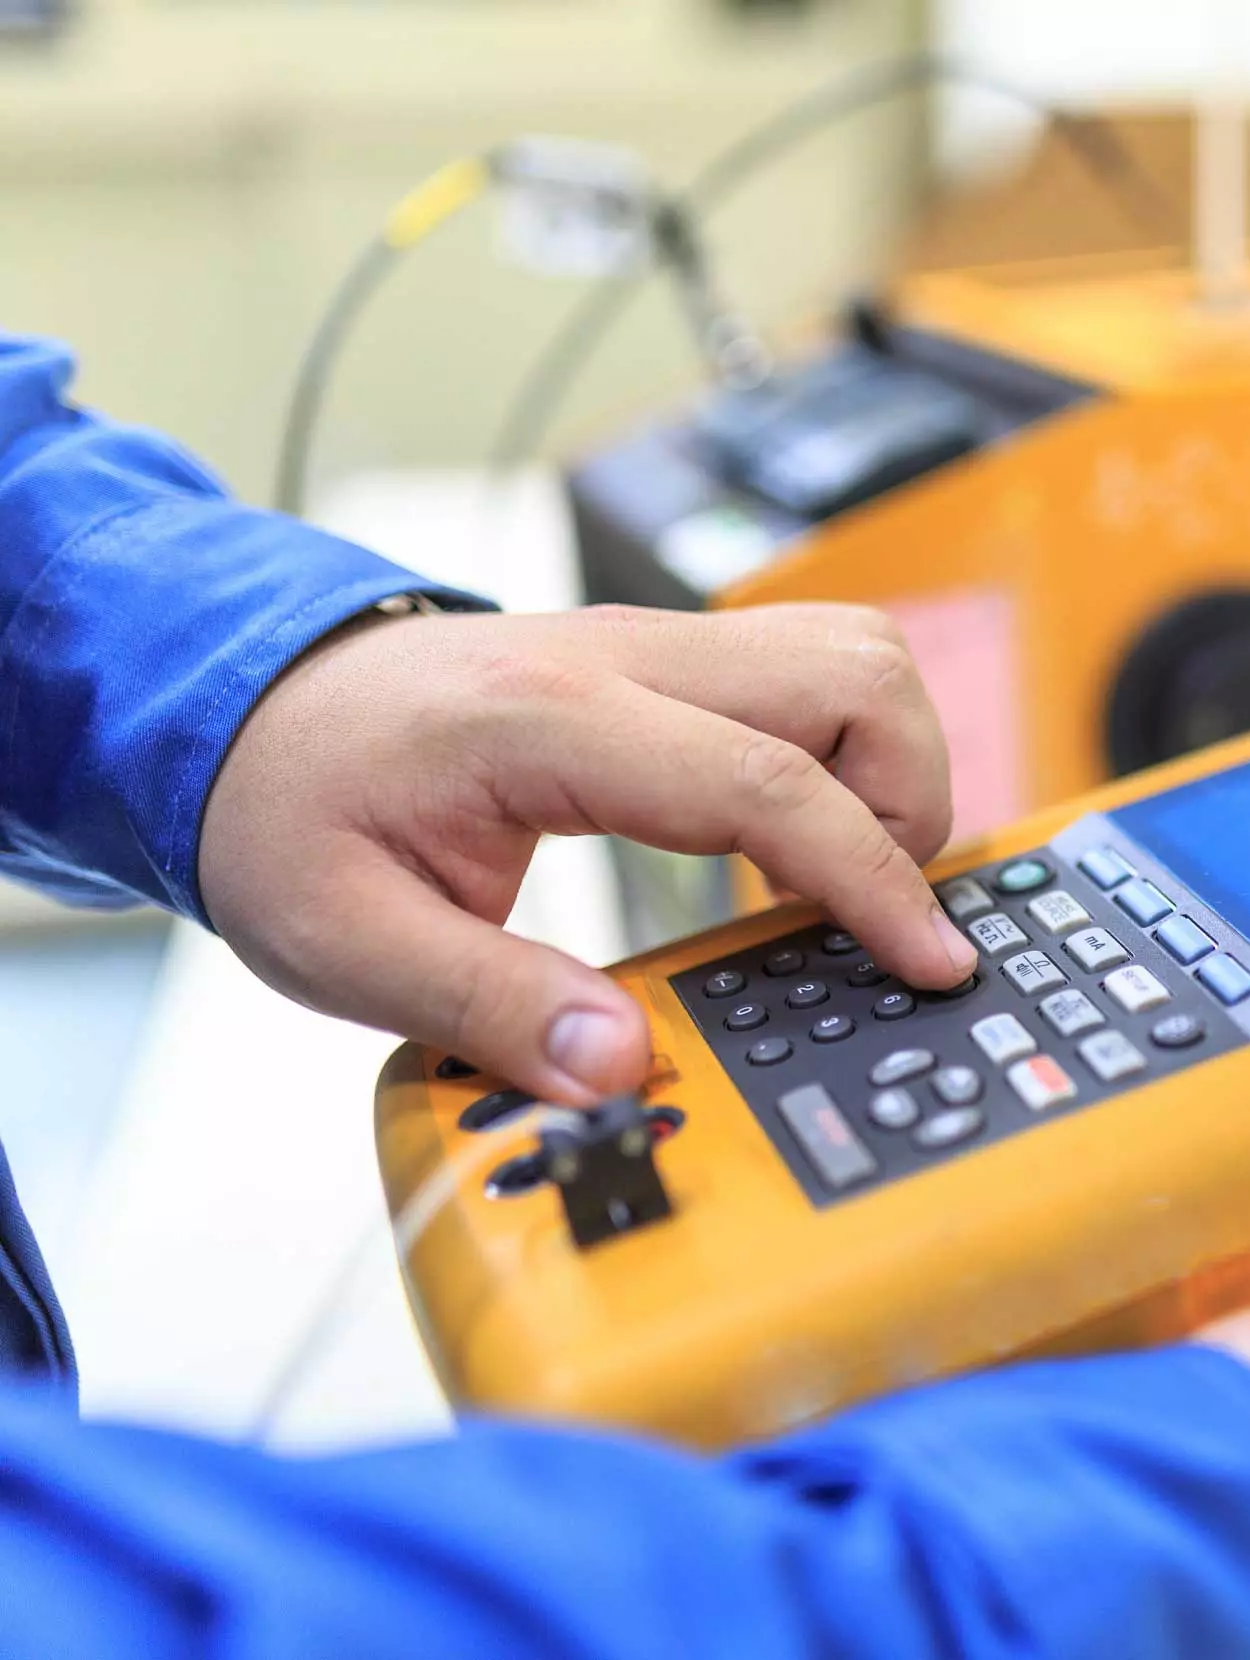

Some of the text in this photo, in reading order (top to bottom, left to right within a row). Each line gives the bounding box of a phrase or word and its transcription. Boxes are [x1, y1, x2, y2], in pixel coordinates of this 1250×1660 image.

[1085, 936, 1106, 951] mA
[857, 962, 875, 972] 5
[797, 984, 814, 994] 2
[884, 995, 901, 1004] 6
[736, 1006, 753, 1016] 0
[821, 1017, 839, 1028] 3
